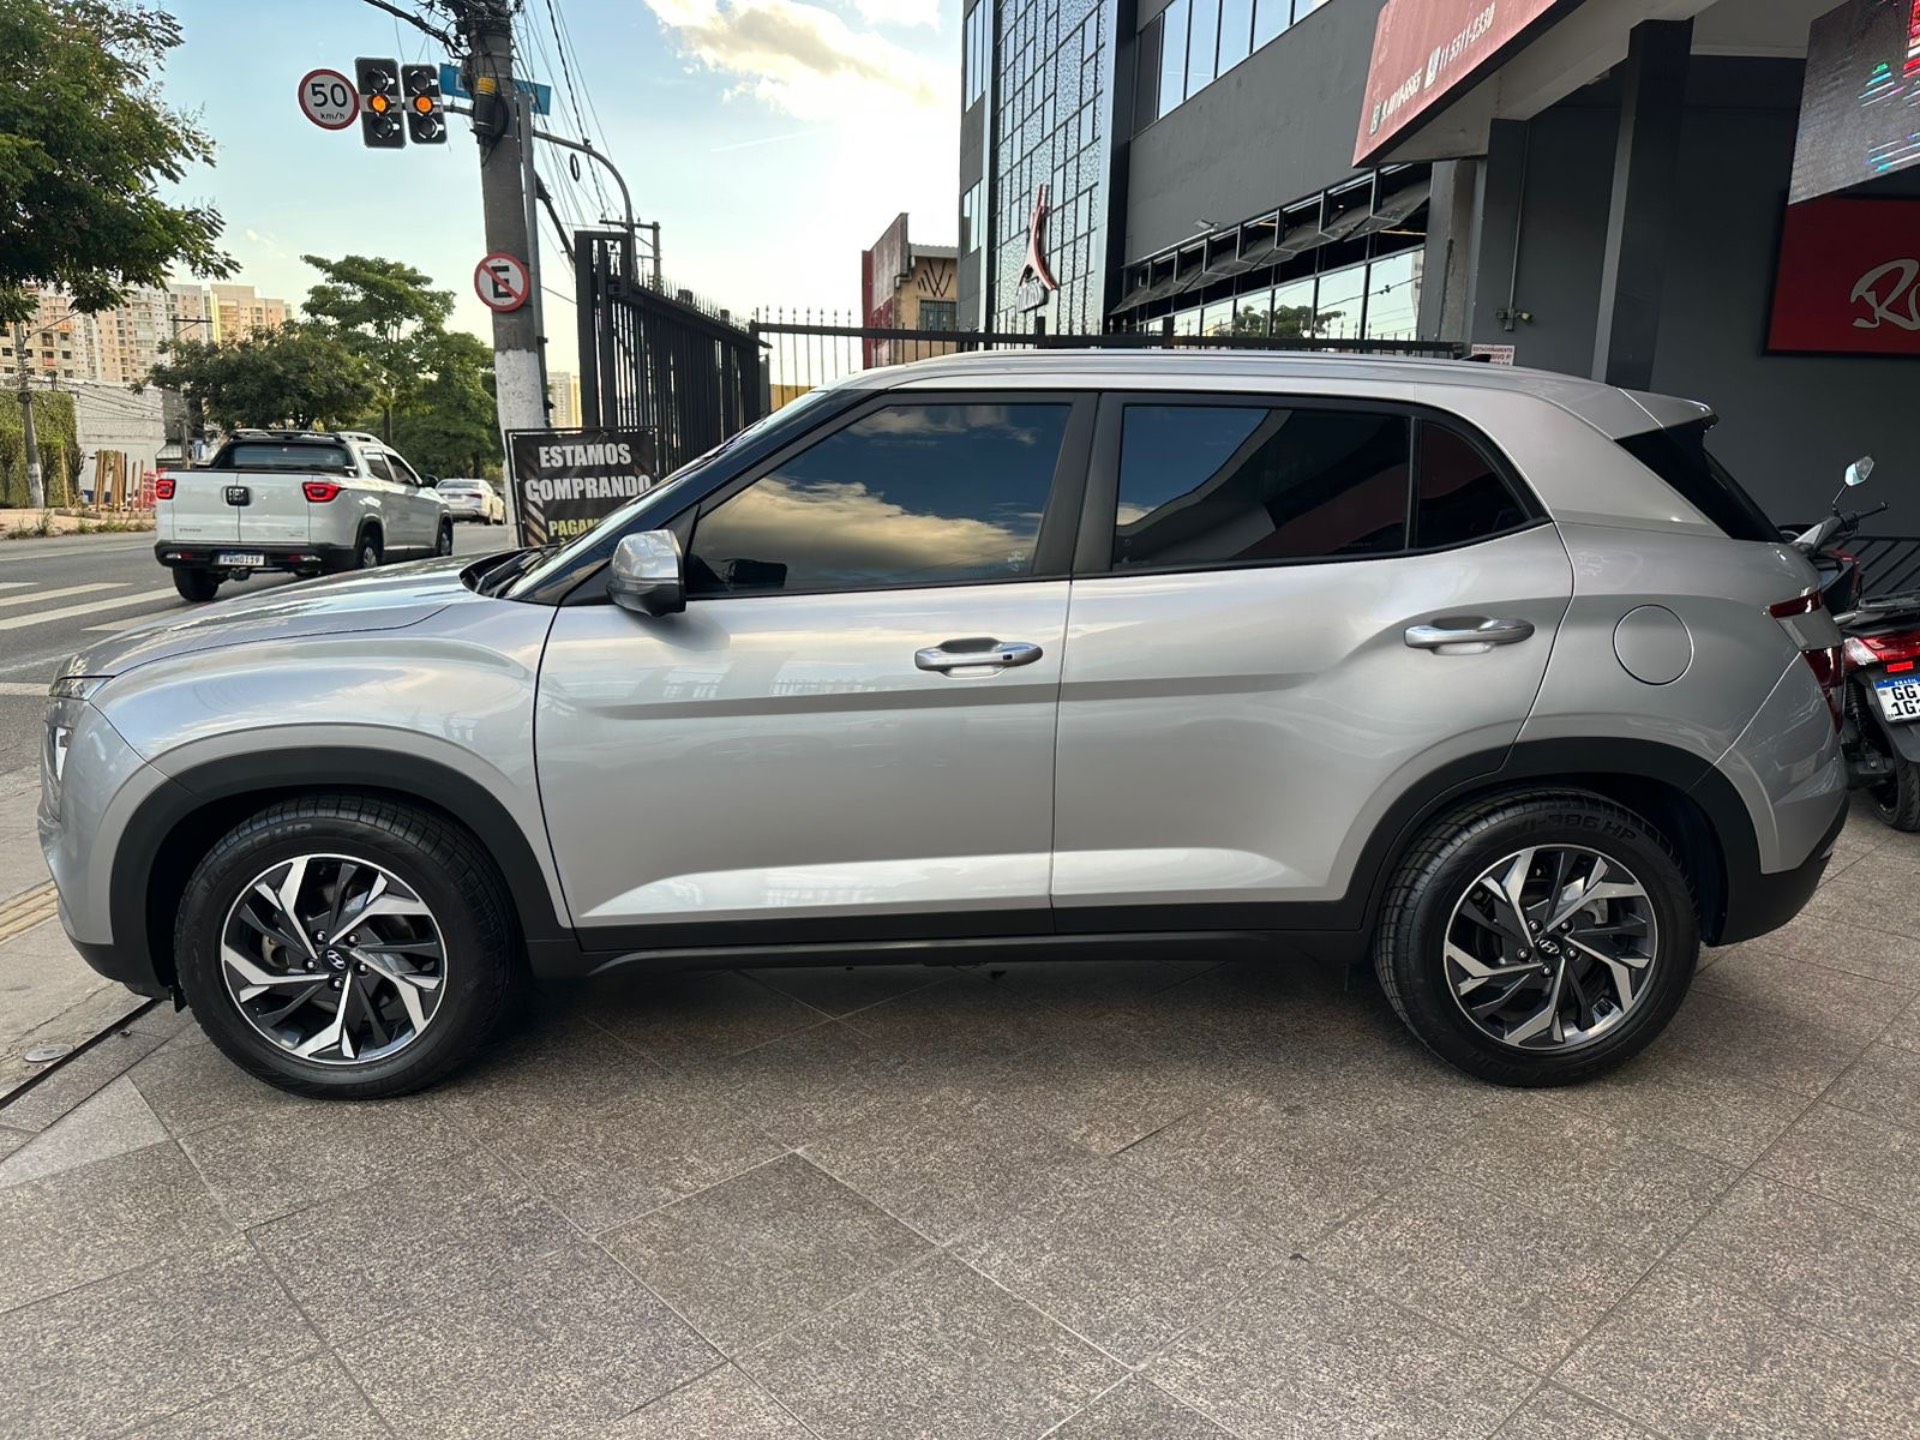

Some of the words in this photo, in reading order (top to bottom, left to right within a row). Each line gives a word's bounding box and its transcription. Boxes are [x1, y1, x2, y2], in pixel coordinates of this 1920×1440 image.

[310, 83, 347, 107] 50
[320, 111, 345, 120] km/h
[491, 265, 512, 298] E
[538, 443, 632, 468] ESTAMOS
[524, 474, 651, 503] COMPRANDO
[1891, 684, 1920, 701] GG
